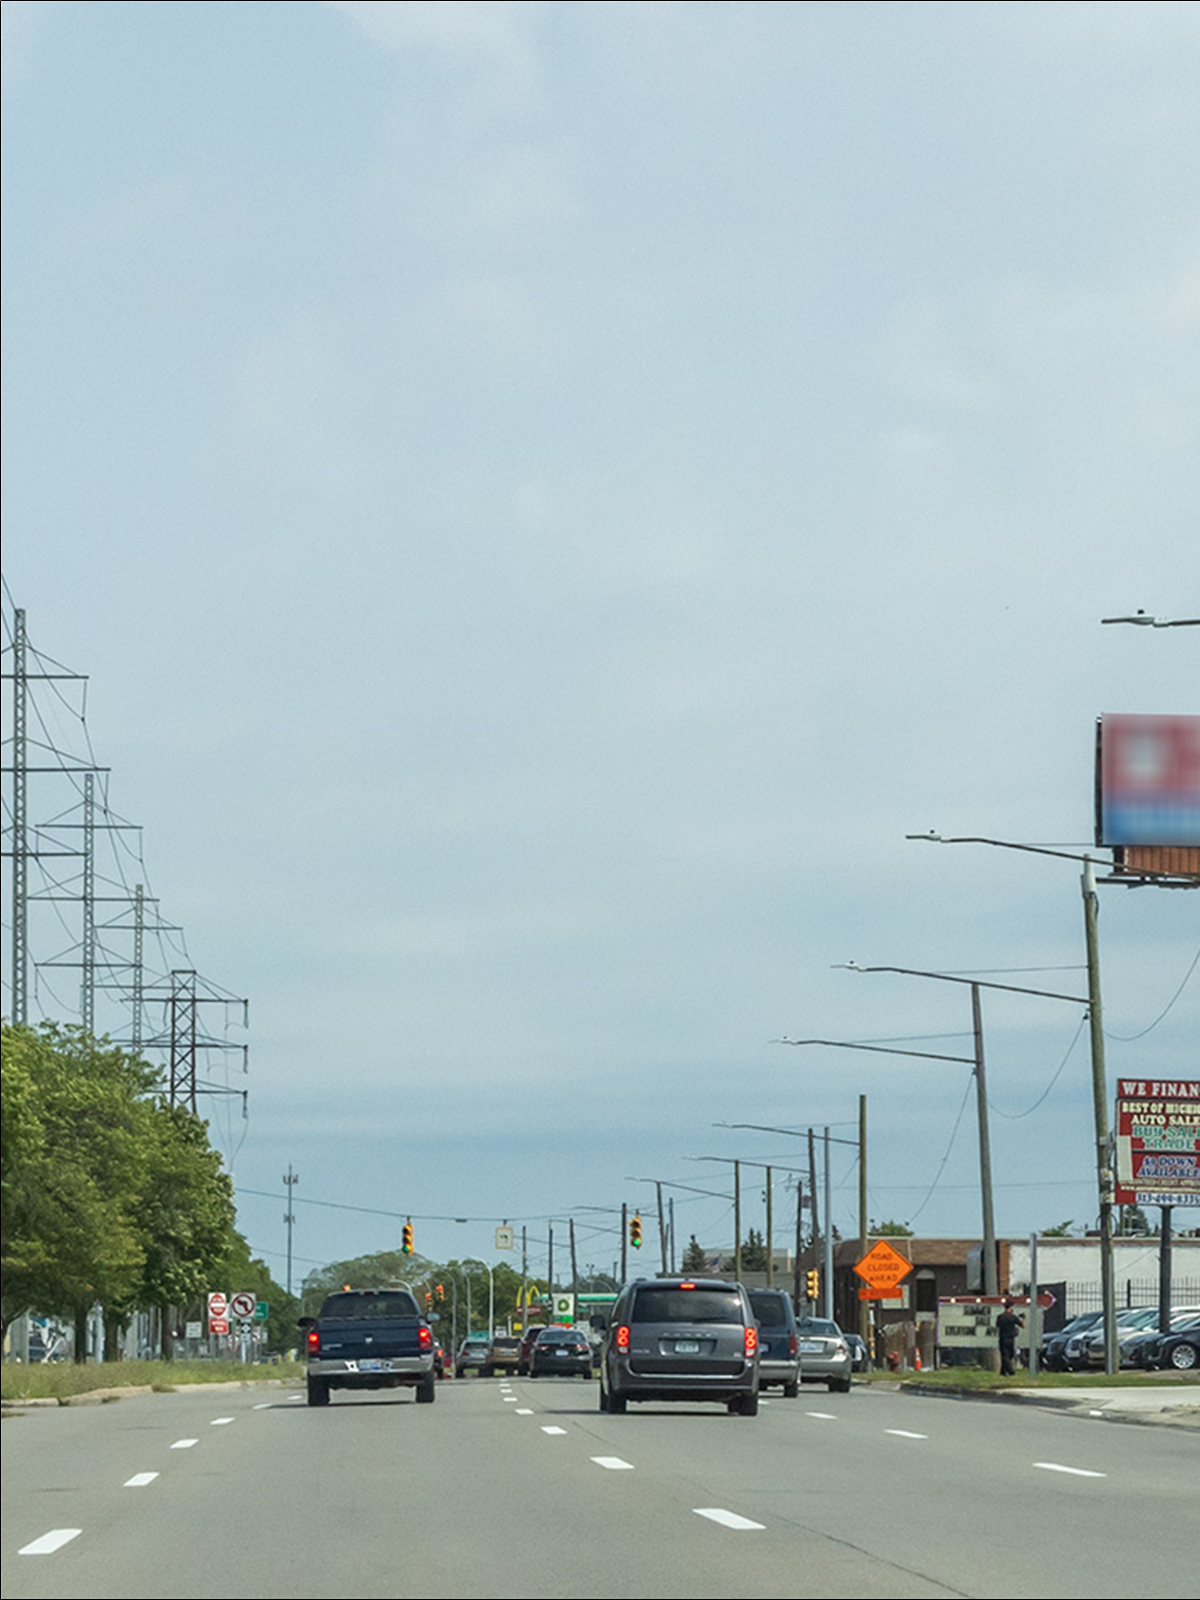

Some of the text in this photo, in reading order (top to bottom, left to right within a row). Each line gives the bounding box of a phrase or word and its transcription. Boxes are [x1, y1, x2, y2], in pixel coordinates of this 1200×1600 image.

[1122, 1082, 1146, 1096] WE
[1122, 1102, 1149, 1113] BEST
[1150, 1102, 1164, 1113] OF
[1131, 1114, 1166, 1125] AUTO
[1144, 1138, 1194, 1149] TRADE
[1159, 1156, 1196, 1166] DOWN
[1137, 1168, 1200, 1177] AVAILABLE
[871, 1253, 893, 1261] ROAD
[867, 1263, 900, 1272] CLOSED
[869, 1274, 898, 1282] AHEAD
